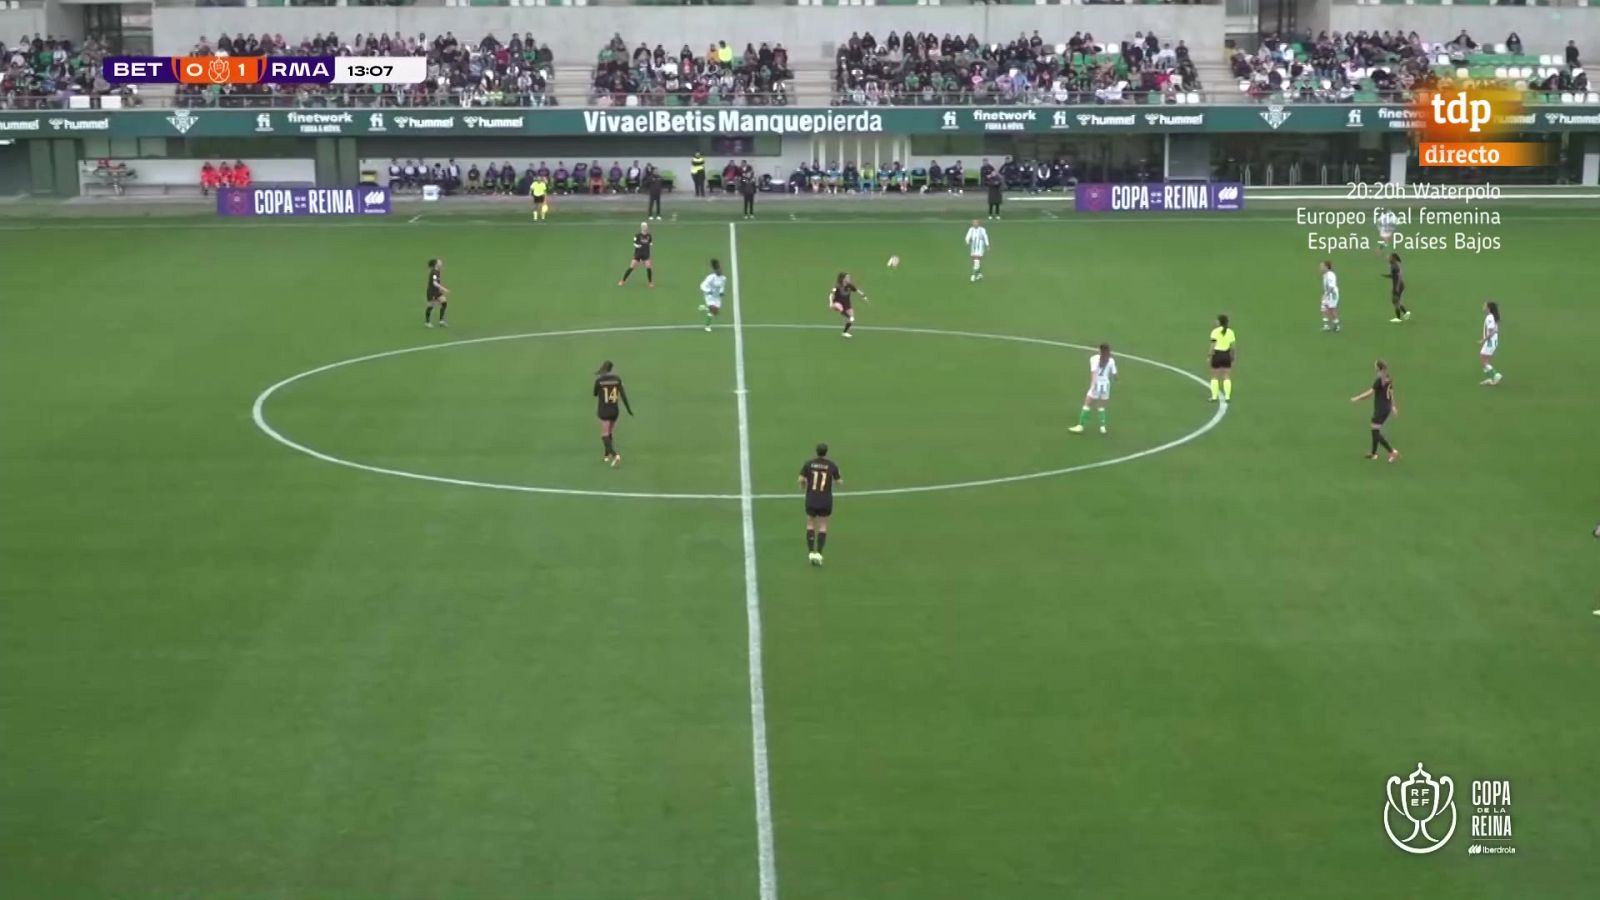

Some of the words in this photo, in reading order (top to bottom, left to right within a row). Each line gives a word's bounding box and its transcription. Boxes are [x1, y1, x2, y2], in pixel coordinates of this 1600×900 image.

[287, 111, 354, 123] finetwork
[973, 109, 1038, 120] finetwork
[1091, 114, 1136, 126] hummel
[1159, 114, 1205, 126] hummel
[0, 119, 40, 130] ummel
[64, 118, 110, 130] hummel
[408, 117, 455, 129] hummel
[478, 117, 525, 129] hummel
[254, 189, 294, 214] COPA
[308, 189, 355, 214] REINA
[1111, 185, 1150, 210] COPA
[1164, 185, 1209, 210] REINA
[602, 386, 618, 403] 14
[811, 471, 827, 491] 11
